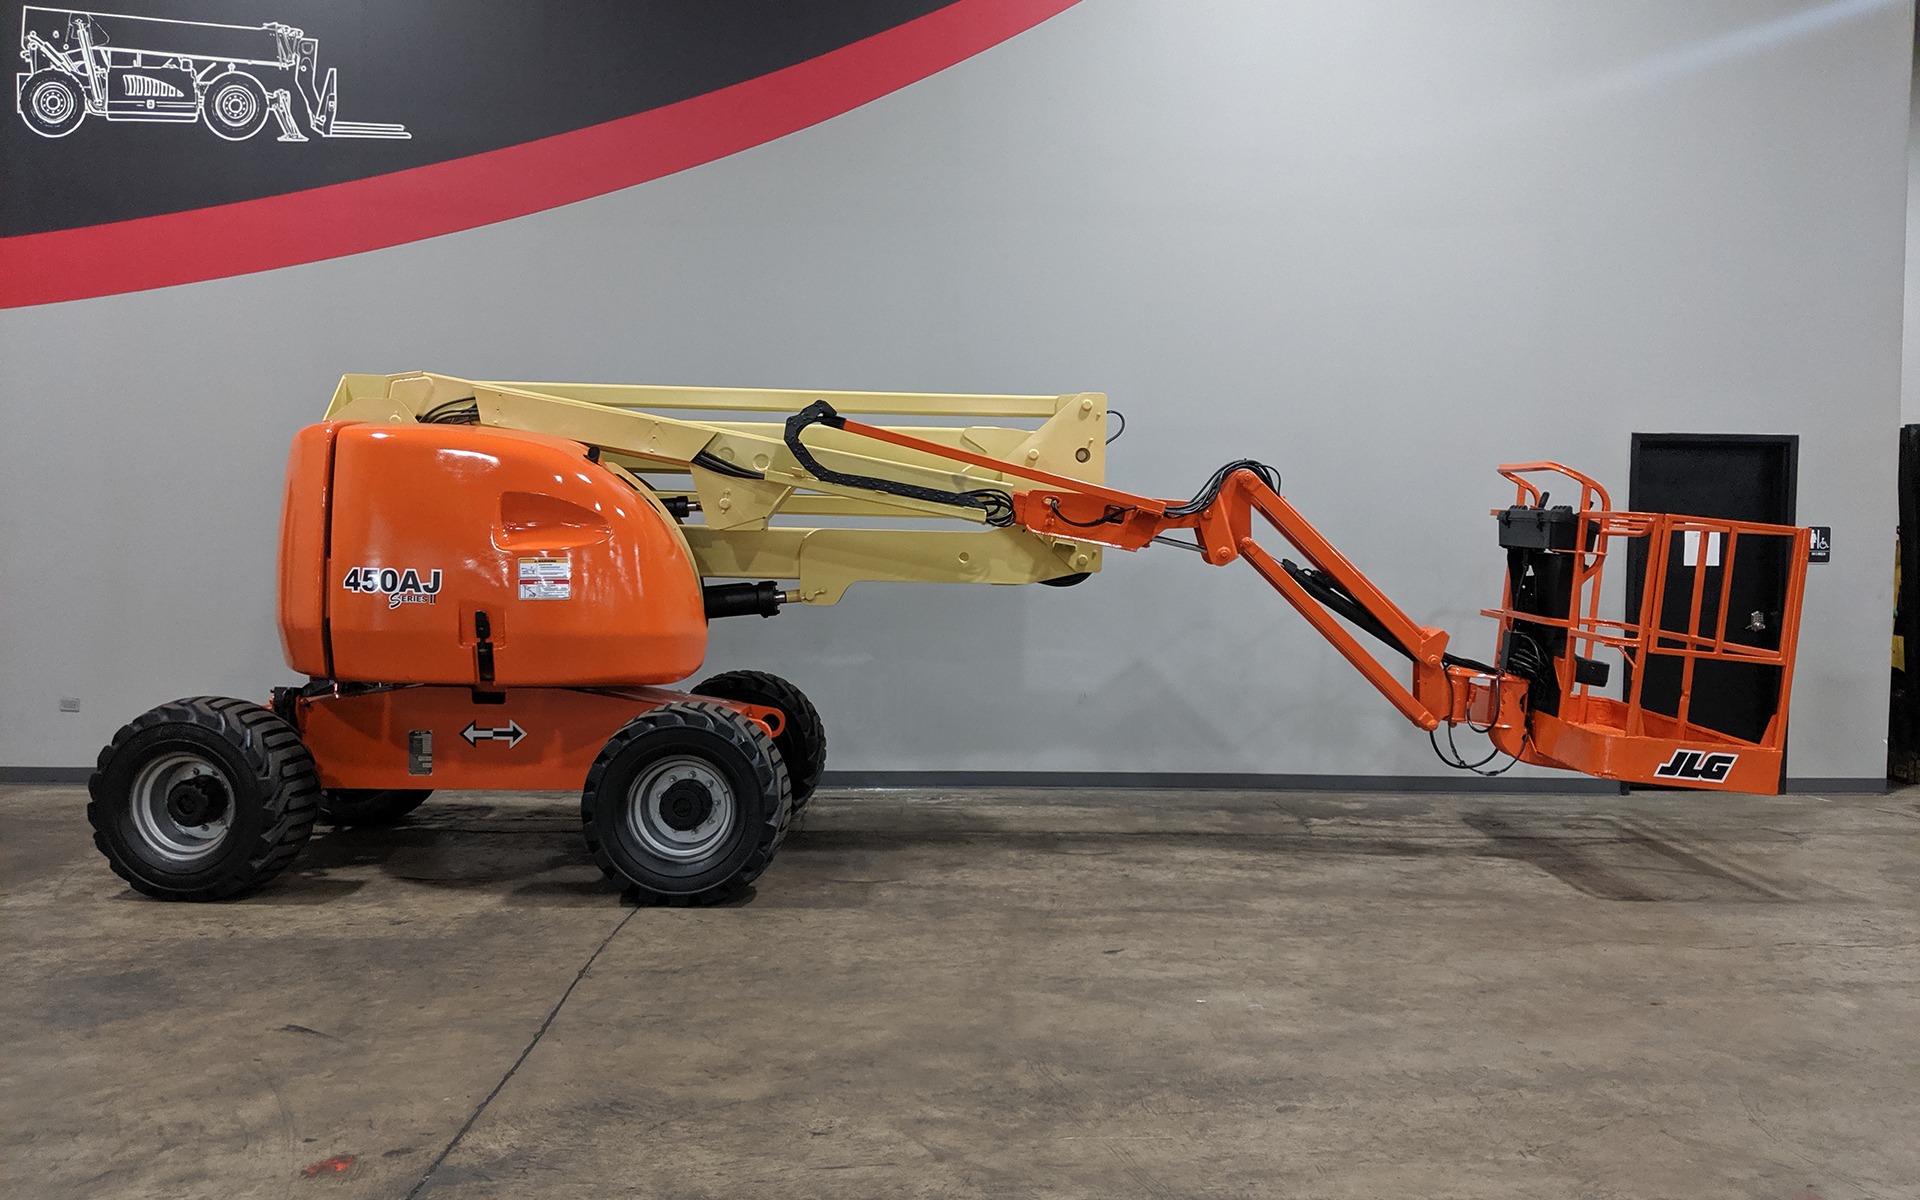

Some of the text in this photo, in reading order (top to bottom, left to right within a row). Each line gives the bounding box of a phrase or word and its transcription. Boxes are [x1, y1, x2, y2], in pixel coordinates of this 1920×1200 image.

[344, 567, 441, 593] 450AJ
[390, 592, 427, 608] SERIES
[1655, 750, 1737, 782] JLG
